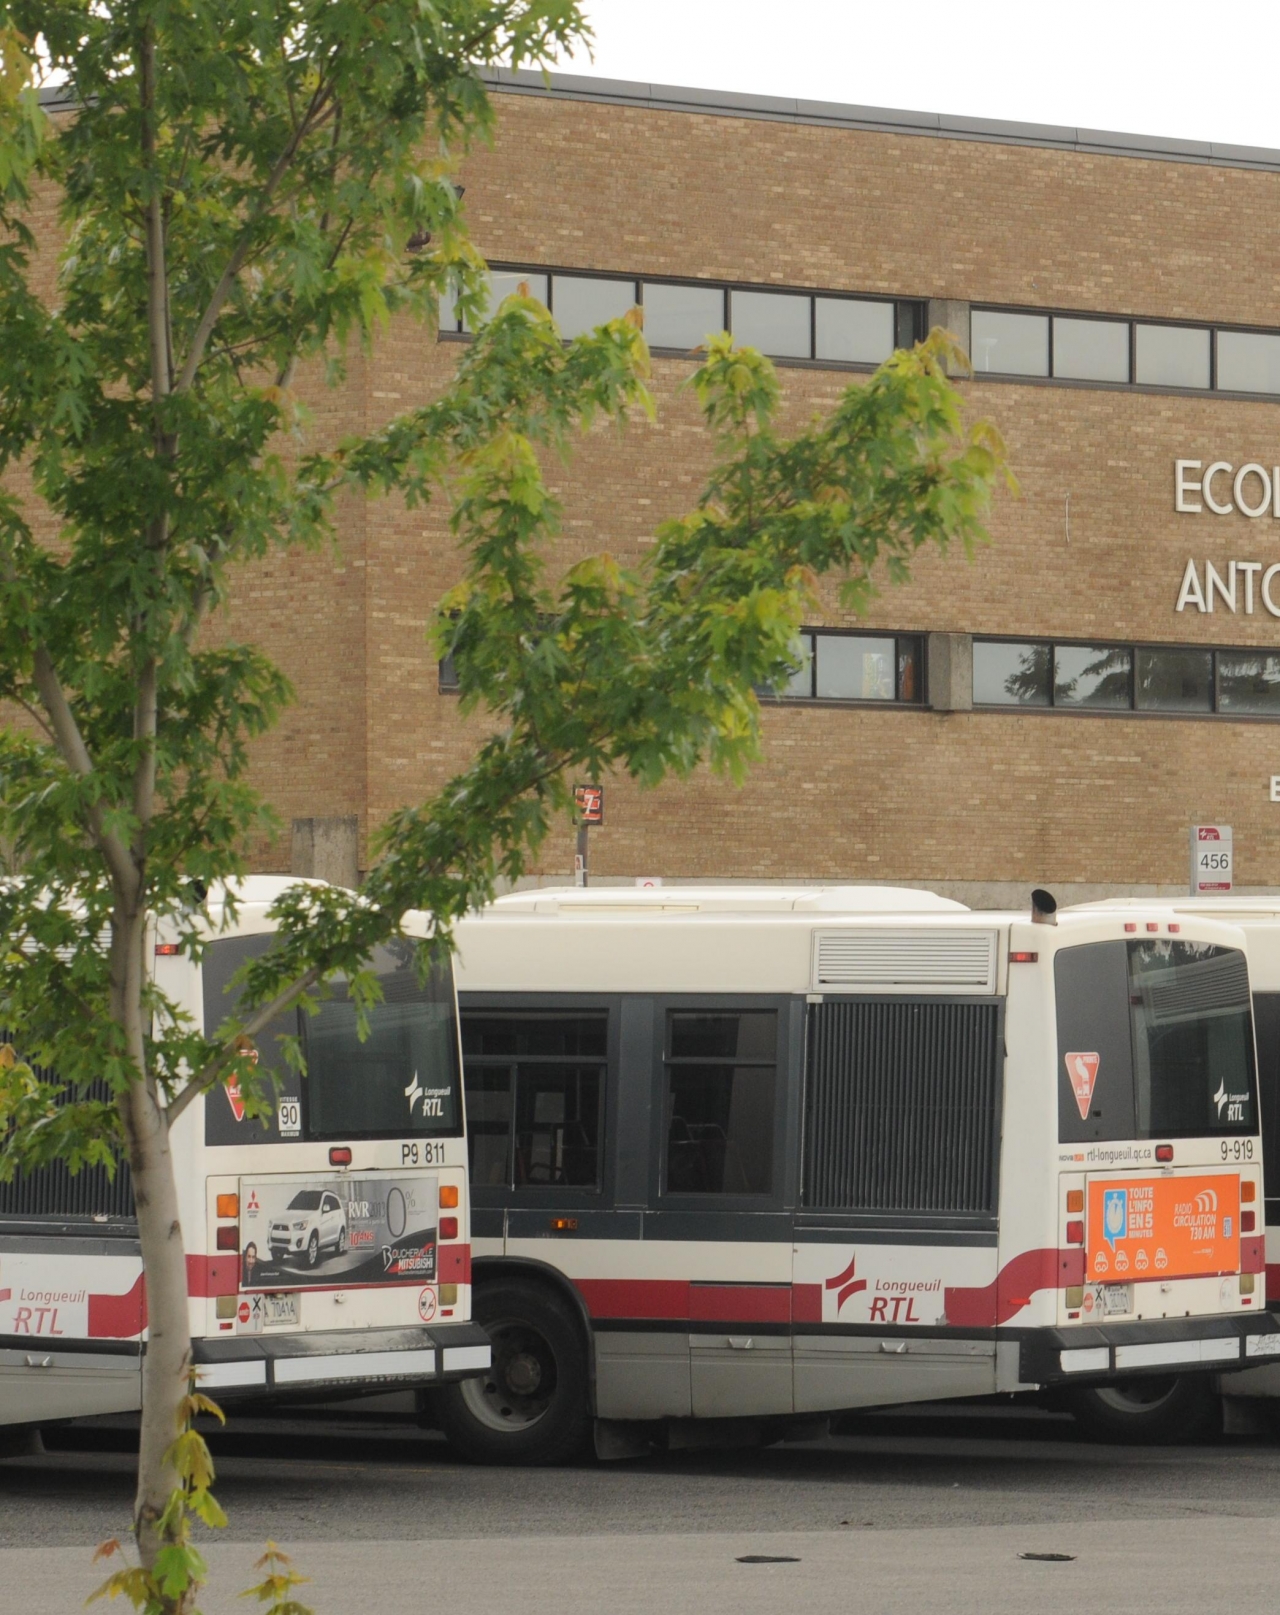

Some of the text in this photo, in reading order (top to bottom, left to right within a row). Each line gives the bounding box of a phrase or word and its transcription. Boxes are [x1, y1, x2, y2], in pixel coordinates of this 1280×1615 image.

[1200, 853, 1229, 869] 456
[424, 1086, 451, 1099] Longueuil
[1229, 1092, 1250, 1103] Longueuil
[281, 1106, 298, 1125] 90
[422, 1100, 444, 1117] RTL
[1227, 1104, 1245, 1121] RTL
[401, 1143, 446, 1165] P9 811
[1087, 1147, 1151, 1163] rtl-longueuil.qc.ca
[1220, 1140, 1254, 1161] 9-919
[1129, 1187, 1153, 1199] TOUTE
[1129, 1200, 1153, 1212] L'INFO
[1174, 1203, 1192, 1215] RADIO
[1129, 1213, 1153, 1229] EN 5
[1173, 1214, 1217, 1227] CIRCULATION
[1129, 1230, 1153, 1238] MINUTES
[1190, 1227, 1203, 1240] 730
[1203, 1226, 1216, 1239] AM
[382, 1245, 433, 1271] BOUCHERVILLE
[398, 1257, 433, 1270] MITSUBISHI
[875, 1279, 942, 1294] Longueuil
[20, 1288, 87, 1305] Longueuil
[868, 1297, 920, 1322] RTL
[12, 1306, 64, 1335] RTL
